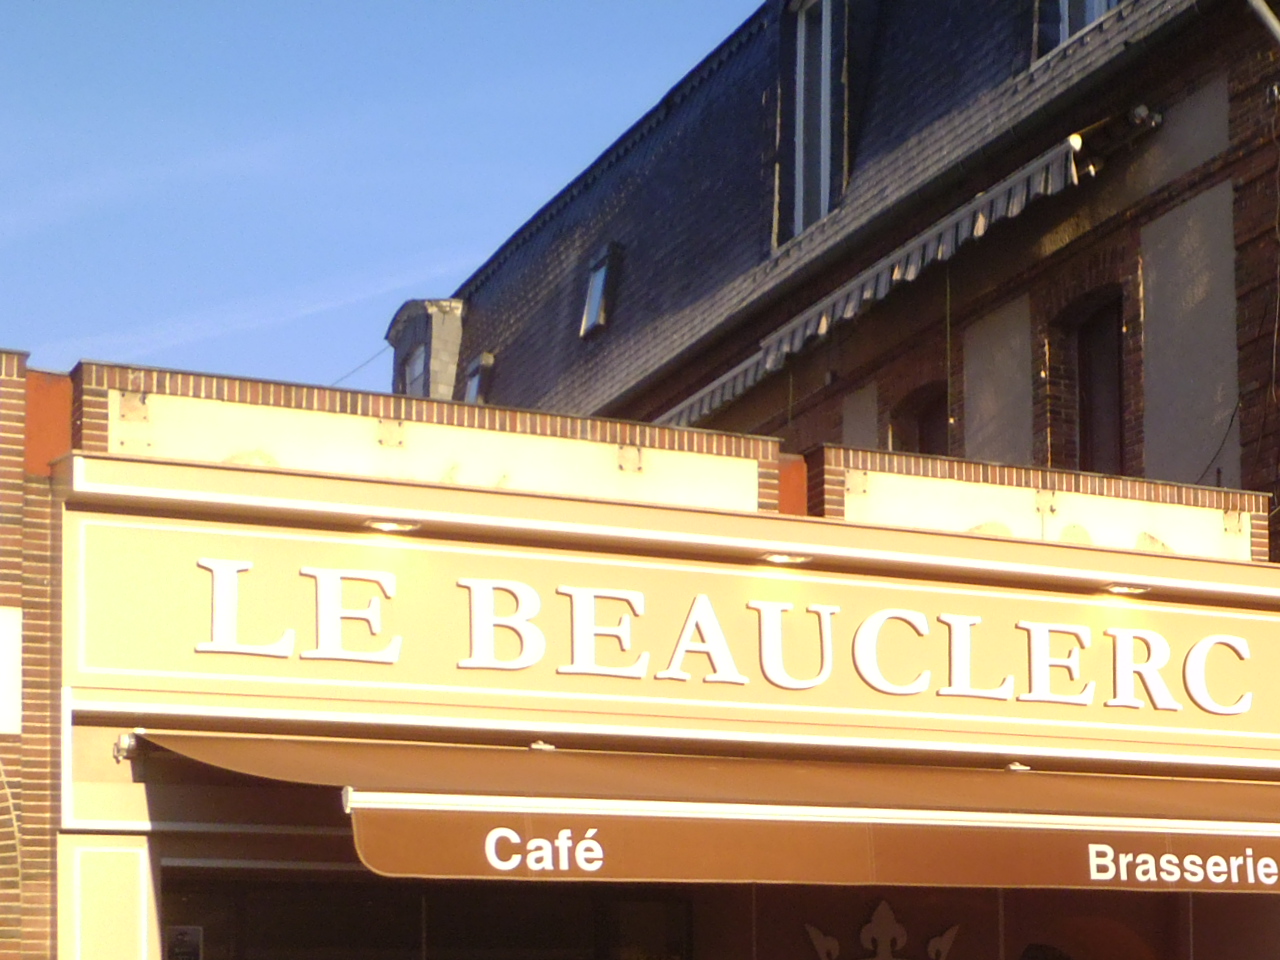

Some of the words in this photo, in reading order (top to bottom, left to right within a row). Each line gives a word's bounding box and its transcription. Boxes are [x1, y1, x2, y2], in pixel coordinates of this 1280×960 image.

[195, 557, 402, 664] LE
[456, 577, 1253, 716] BEAUCLERC
[484, 827, 604, 872] Café
[1087, 843, 1279, 885] Brasserie
